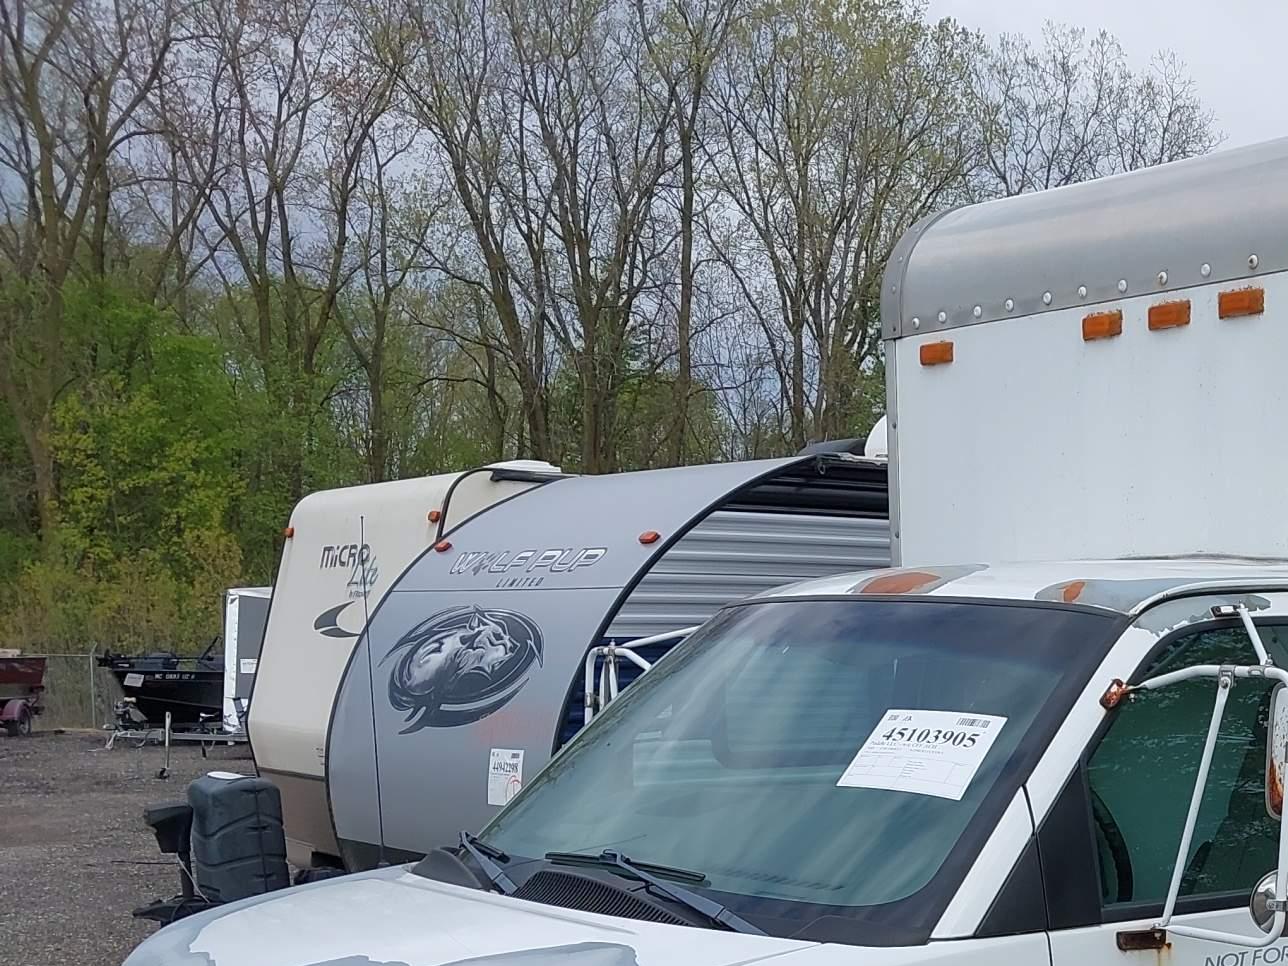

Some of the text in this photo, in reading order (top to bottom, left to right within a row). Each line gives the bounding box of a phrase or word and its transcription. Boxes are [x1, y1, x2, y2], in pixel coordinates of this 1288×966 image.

[526, 548, 607, 573] PUP
[496, 577, 544, 587] LIMITED
[882, 727, 980, 748] 45103905
